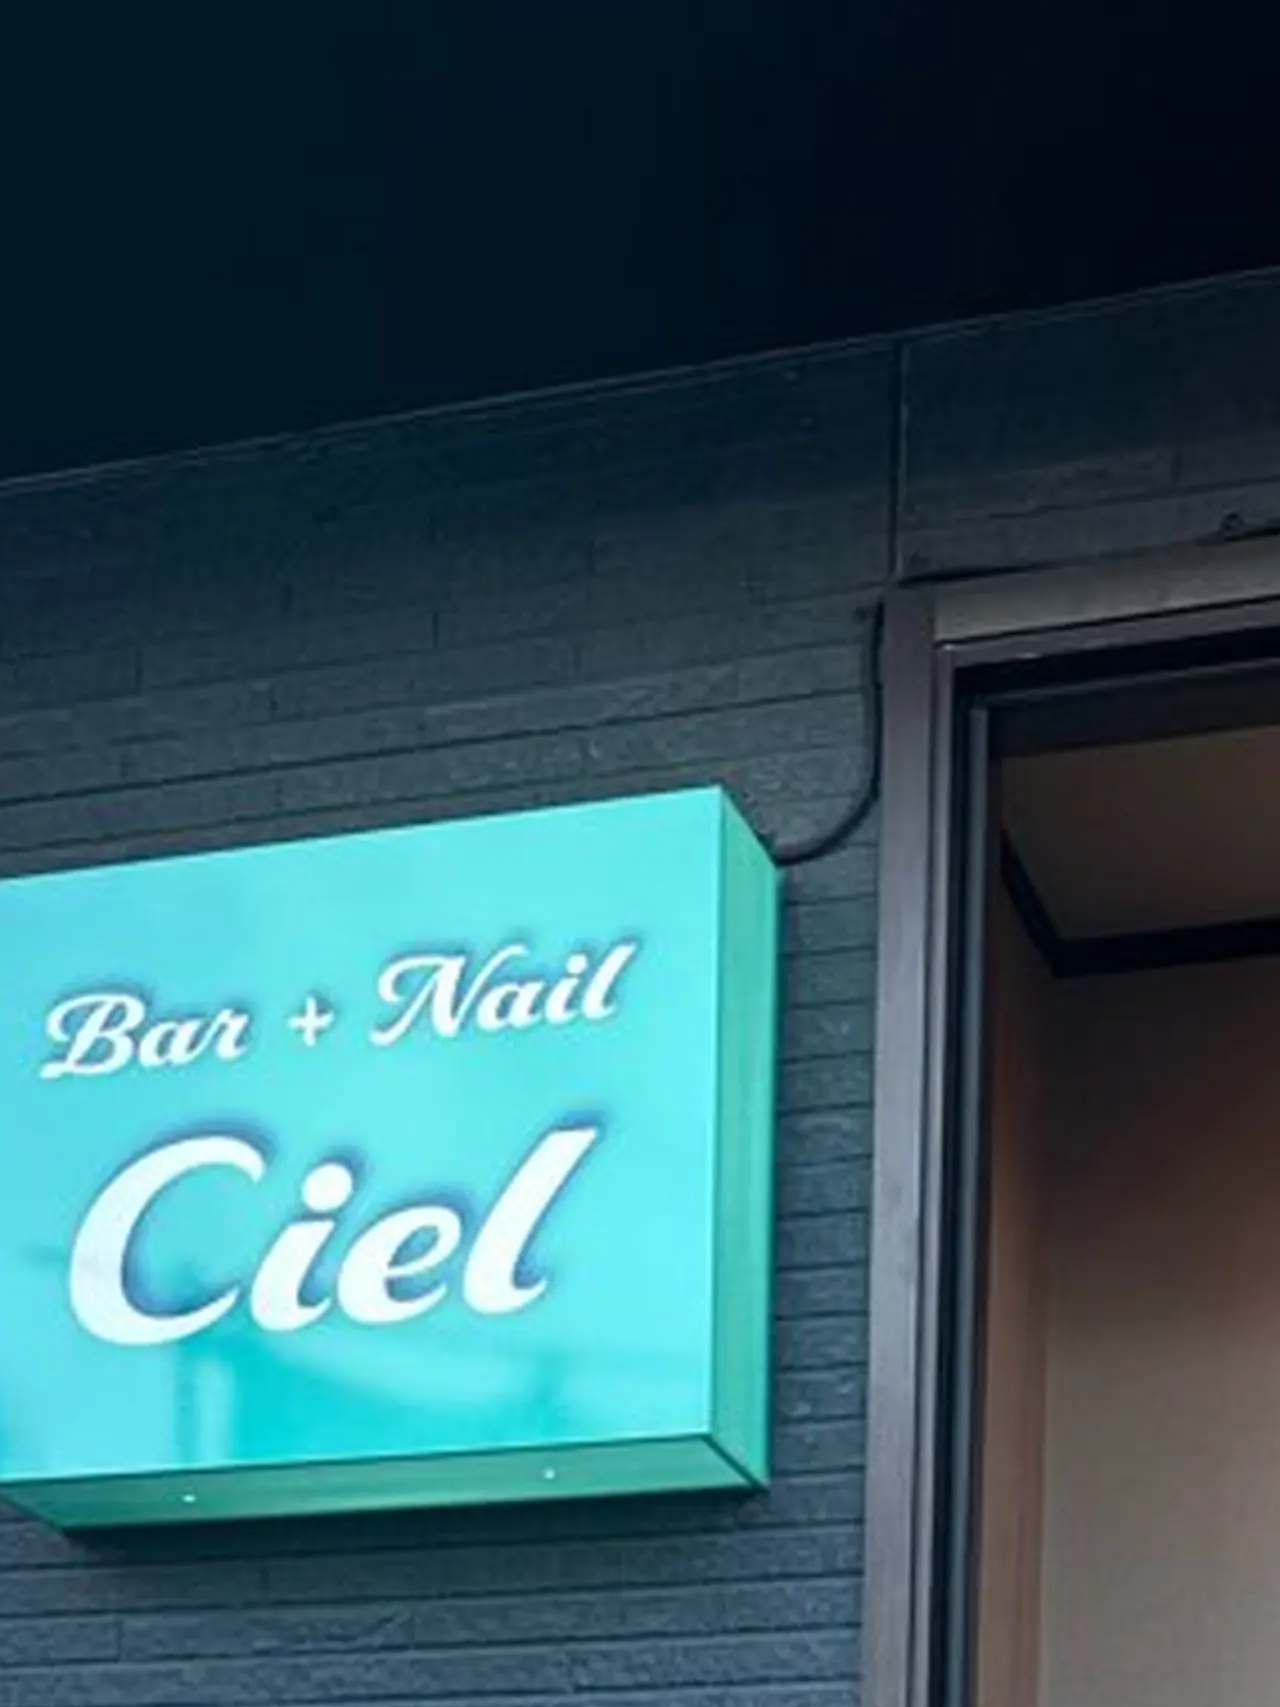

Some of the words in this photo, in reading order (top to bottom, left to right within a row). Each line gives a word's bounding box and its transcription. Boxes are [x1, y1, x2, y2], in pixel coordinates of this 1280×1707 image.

[40, 990, 249, 1080] Bar
[370, 942, 638, 1047] Nail
[70, 1127, 598, 1346] Ciel
